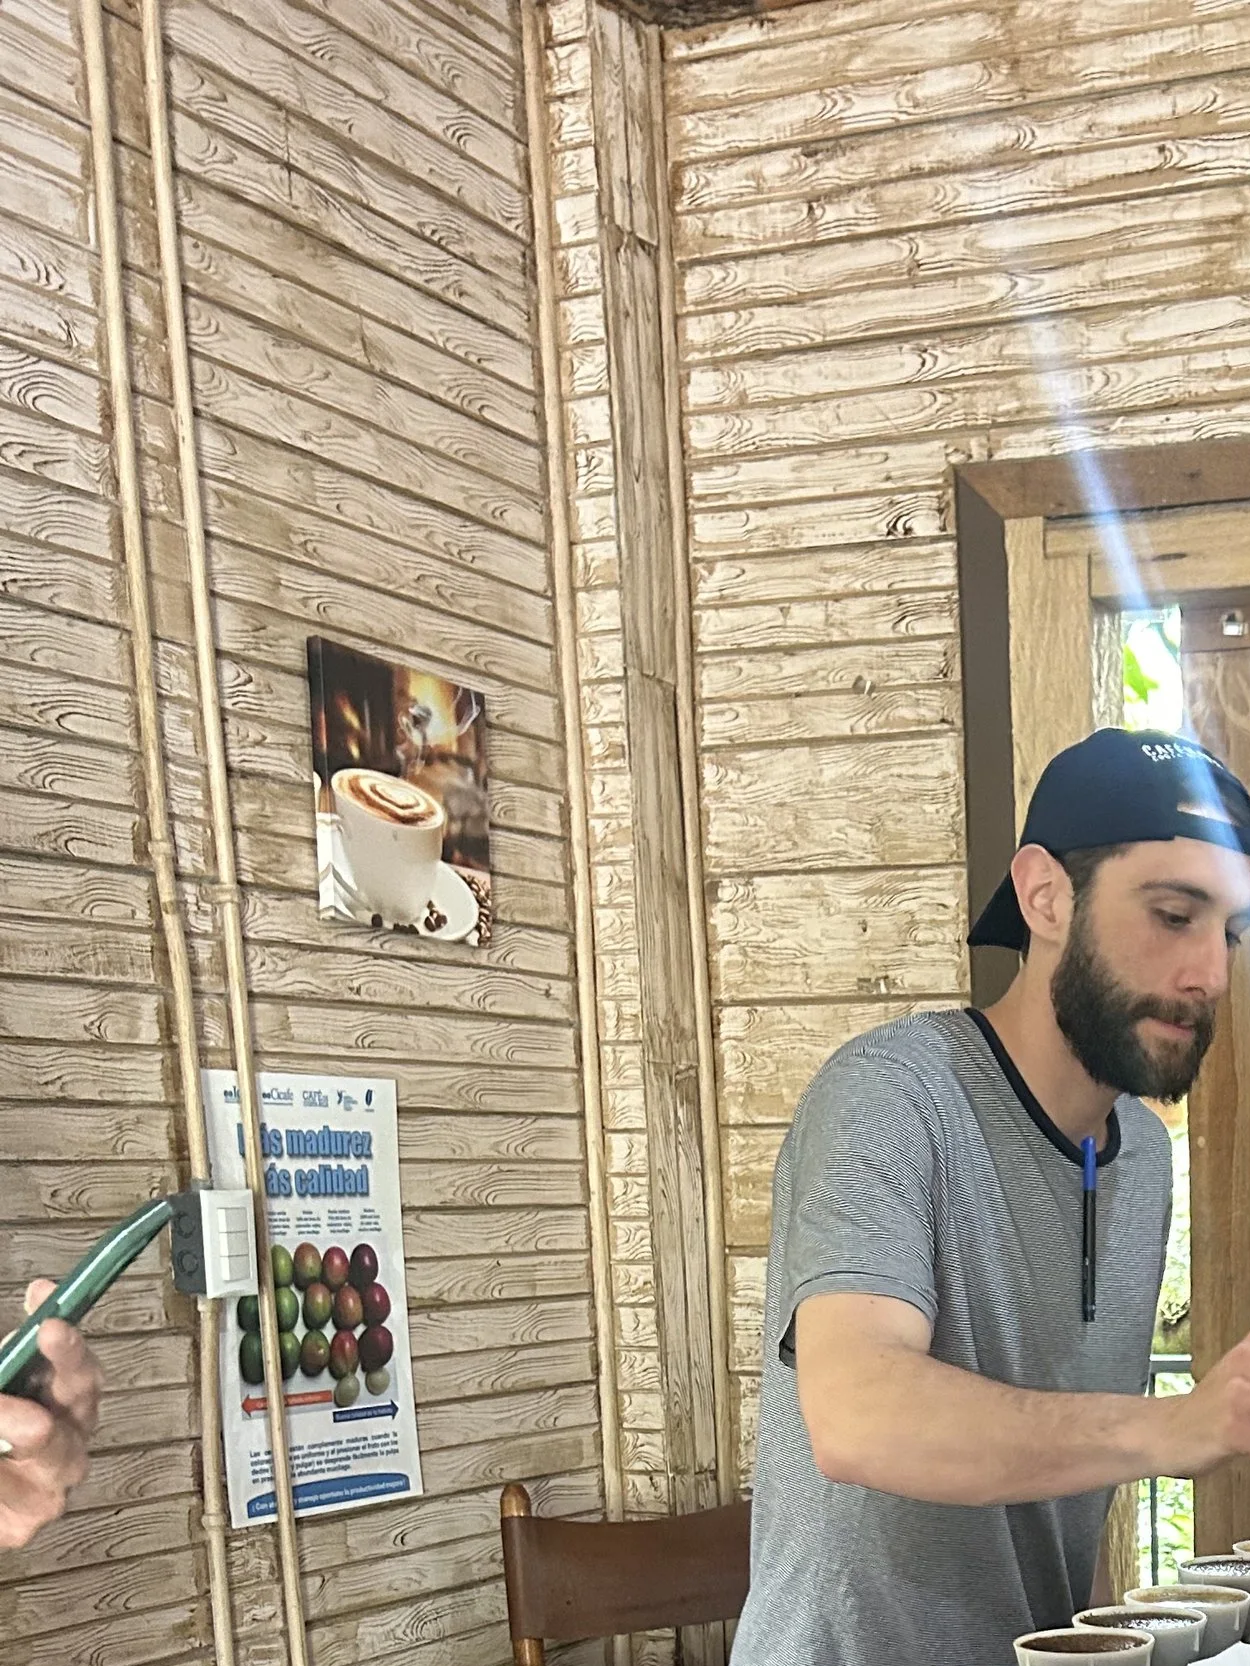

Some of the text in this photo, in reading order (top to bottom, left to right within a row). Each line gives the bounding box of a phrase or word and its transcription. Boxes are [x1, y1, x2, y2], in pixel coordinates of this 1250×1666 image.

[285, 1125, 373, 1158] madurez
[294, 1164, 370, 1198] calidad
[371, 1432, 390, 1440] cuando
